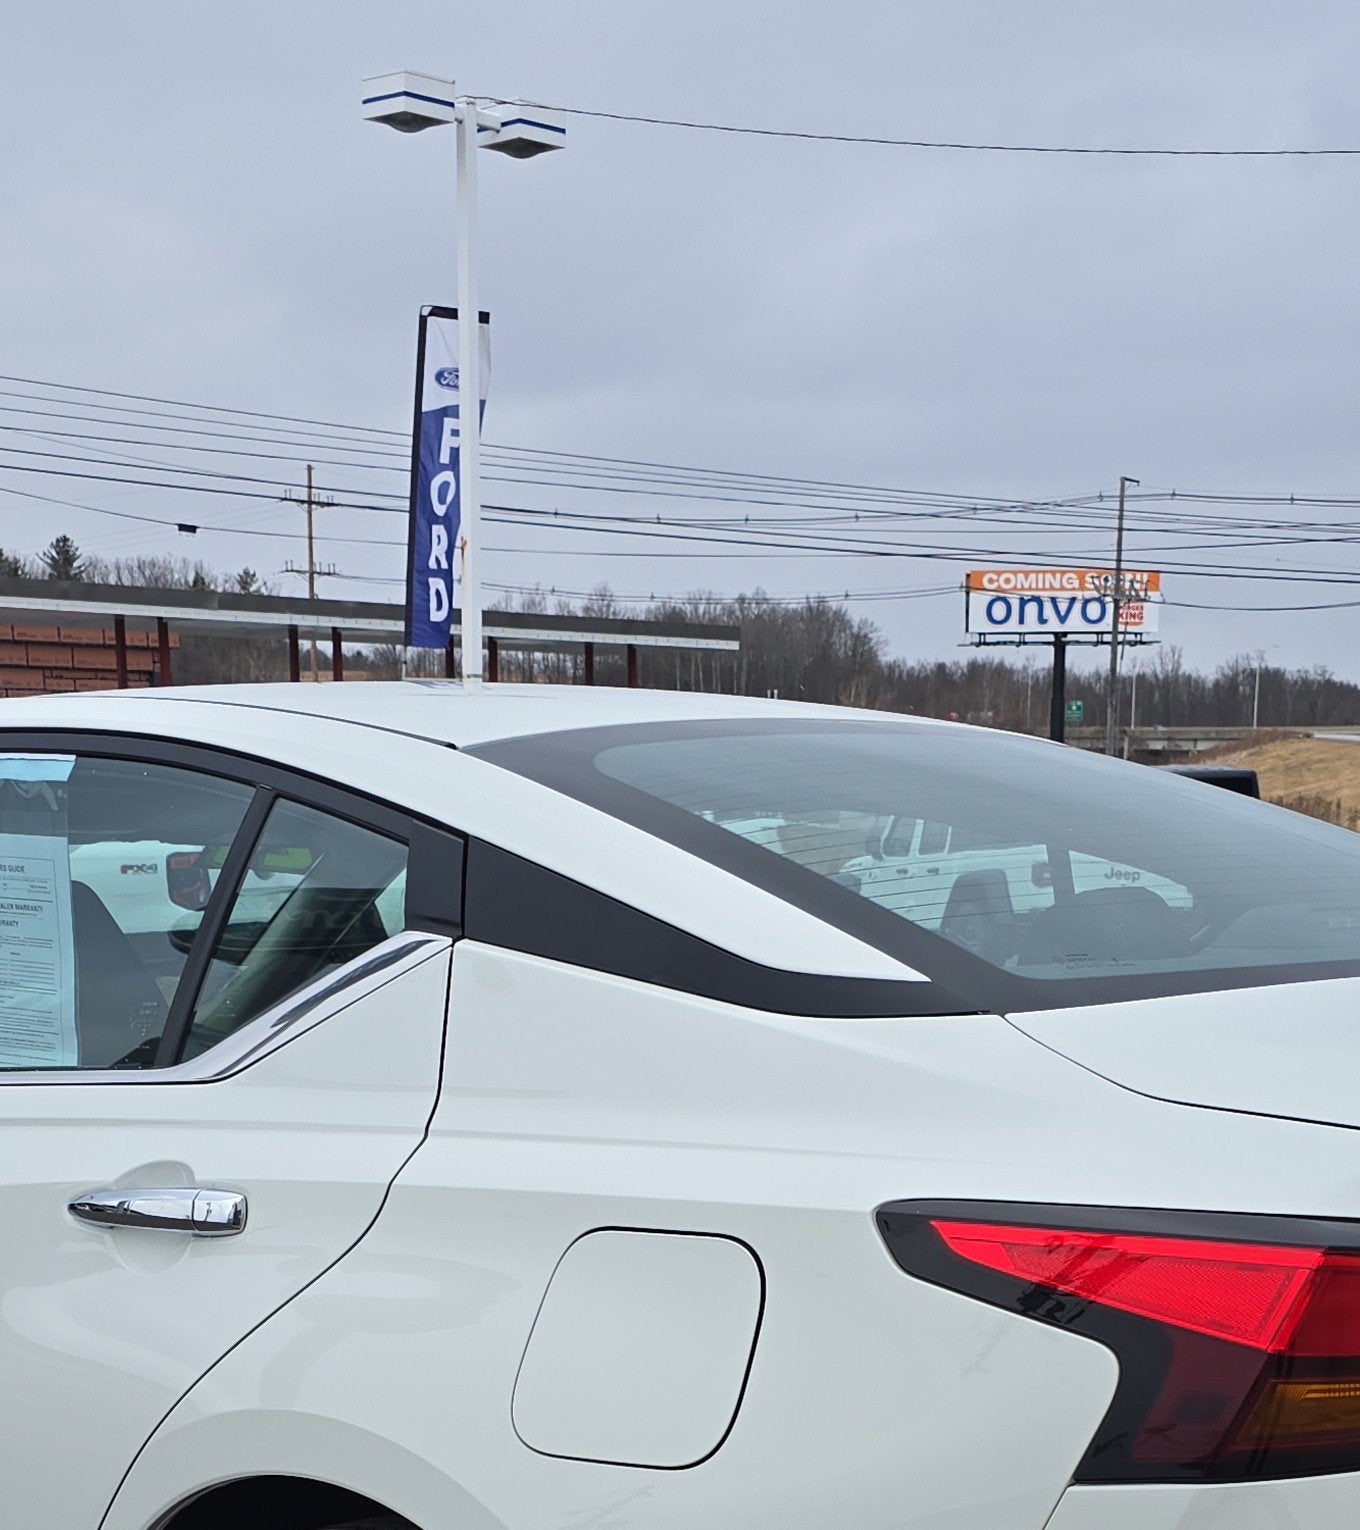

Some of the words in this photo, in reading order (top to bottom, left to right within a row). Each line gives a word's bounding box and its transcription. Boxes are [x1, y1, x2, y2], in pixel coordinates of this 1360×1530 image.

[428, 417, 460, 623] FORD
[982, 573, 1080, 590] COMING
[985, 595, 1107, 625] onvo
[1104, 867, 1140, 883] Jeep
